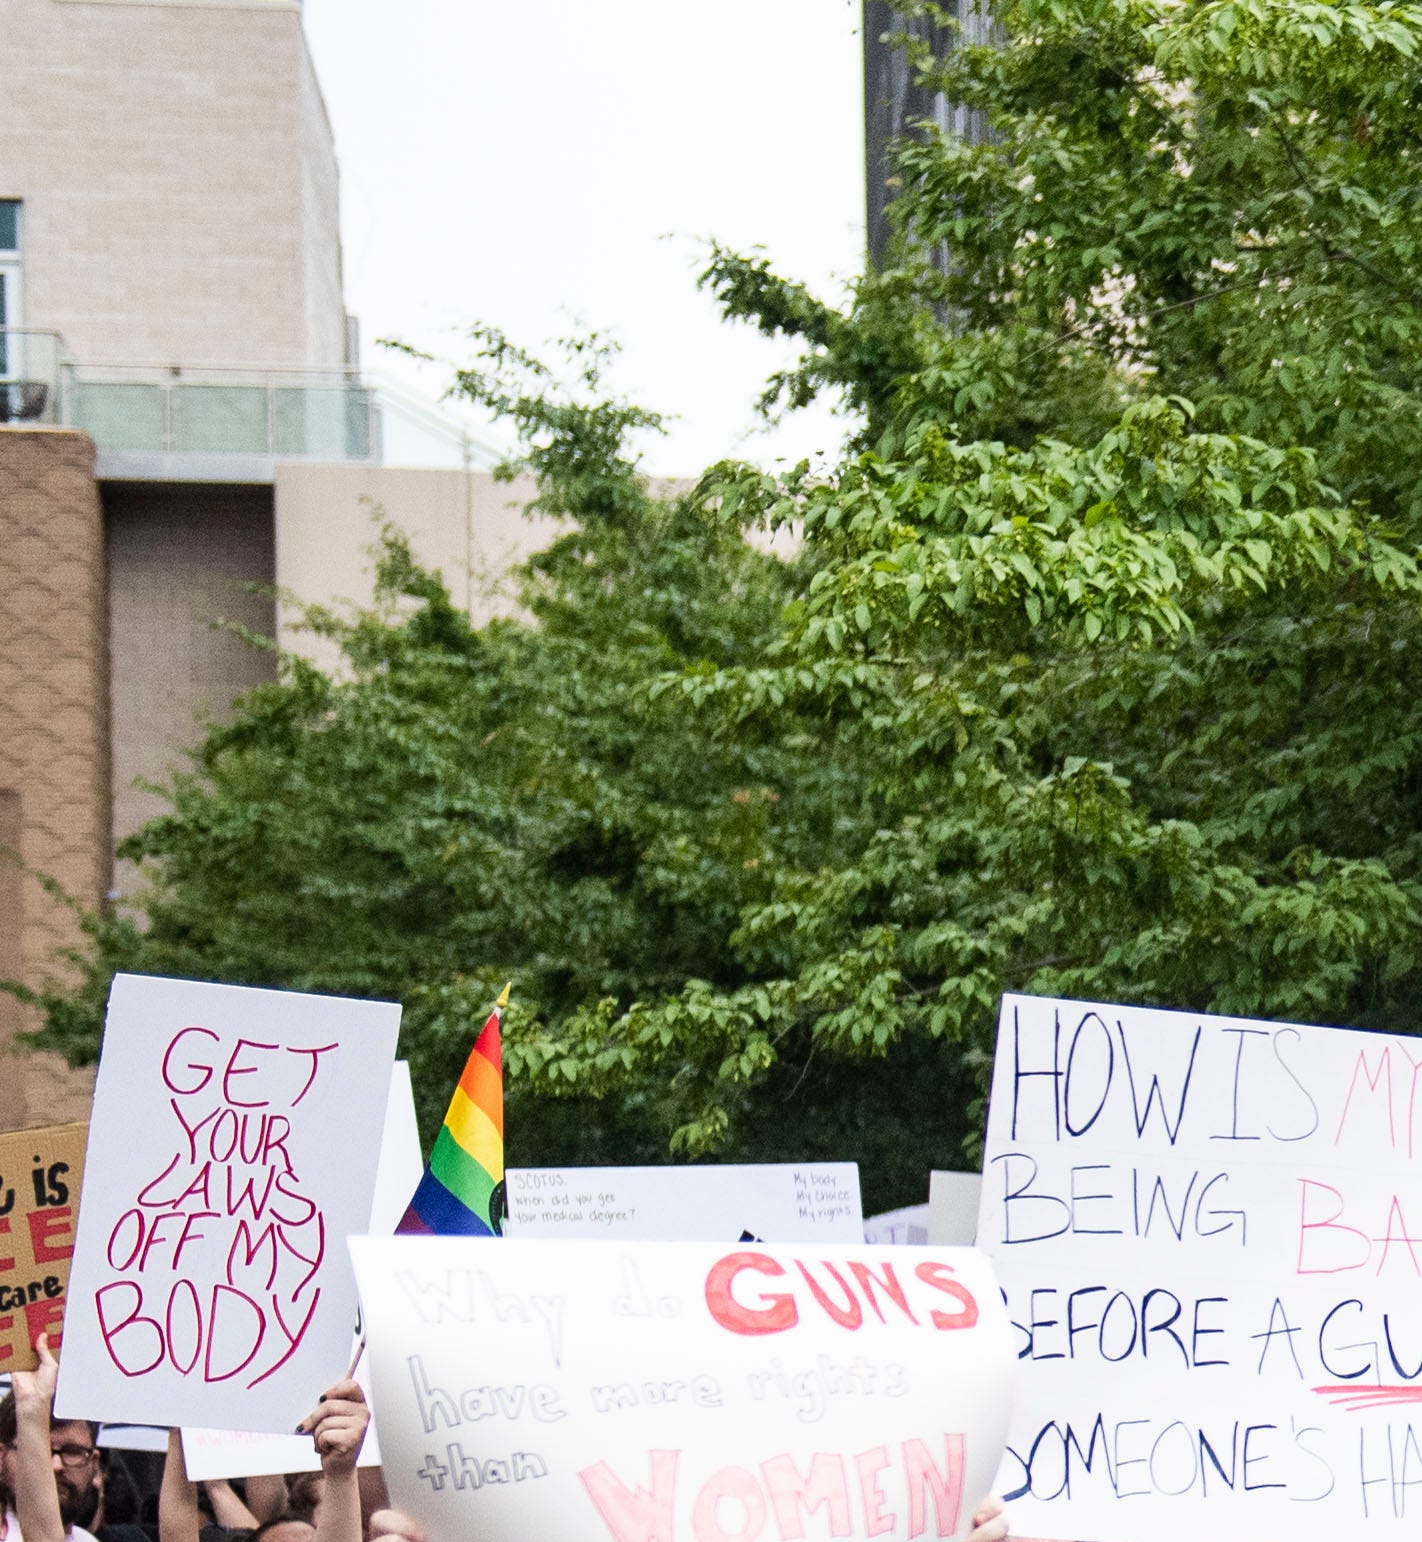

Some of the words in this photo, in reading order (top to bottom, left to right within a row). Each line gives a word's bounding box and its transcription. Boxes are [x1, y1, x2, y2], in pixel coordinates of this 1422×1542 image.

[161, 1026, 340, 1108] GET
[1011, 1005, 1202, 1146] HOW
[1208, 1028, 1320, 1143] IS
[170, 1098, 291, 1172] YOUR
[31, 1155, 71, 1207] is
[137, 1153, 318, 1226] LAWS
[990, 1153, 1247, 1246] BEING
[107, 1211, 225, 1274] OFF
[226, 1212, 326, 1302] MY
[93, 1280, 322, 1391] BODY
[396, 1264, 566, 1368] Why
[704, 1250, 981, 1337] GUNS
[1250, 1297, 1307, 1381] A
[407, 1354, 567, 1434] have
[591, 1371, 725, 1416] more
[749, 1352, 911, 1424] rights
[418, 1442, 549, 1493] than
